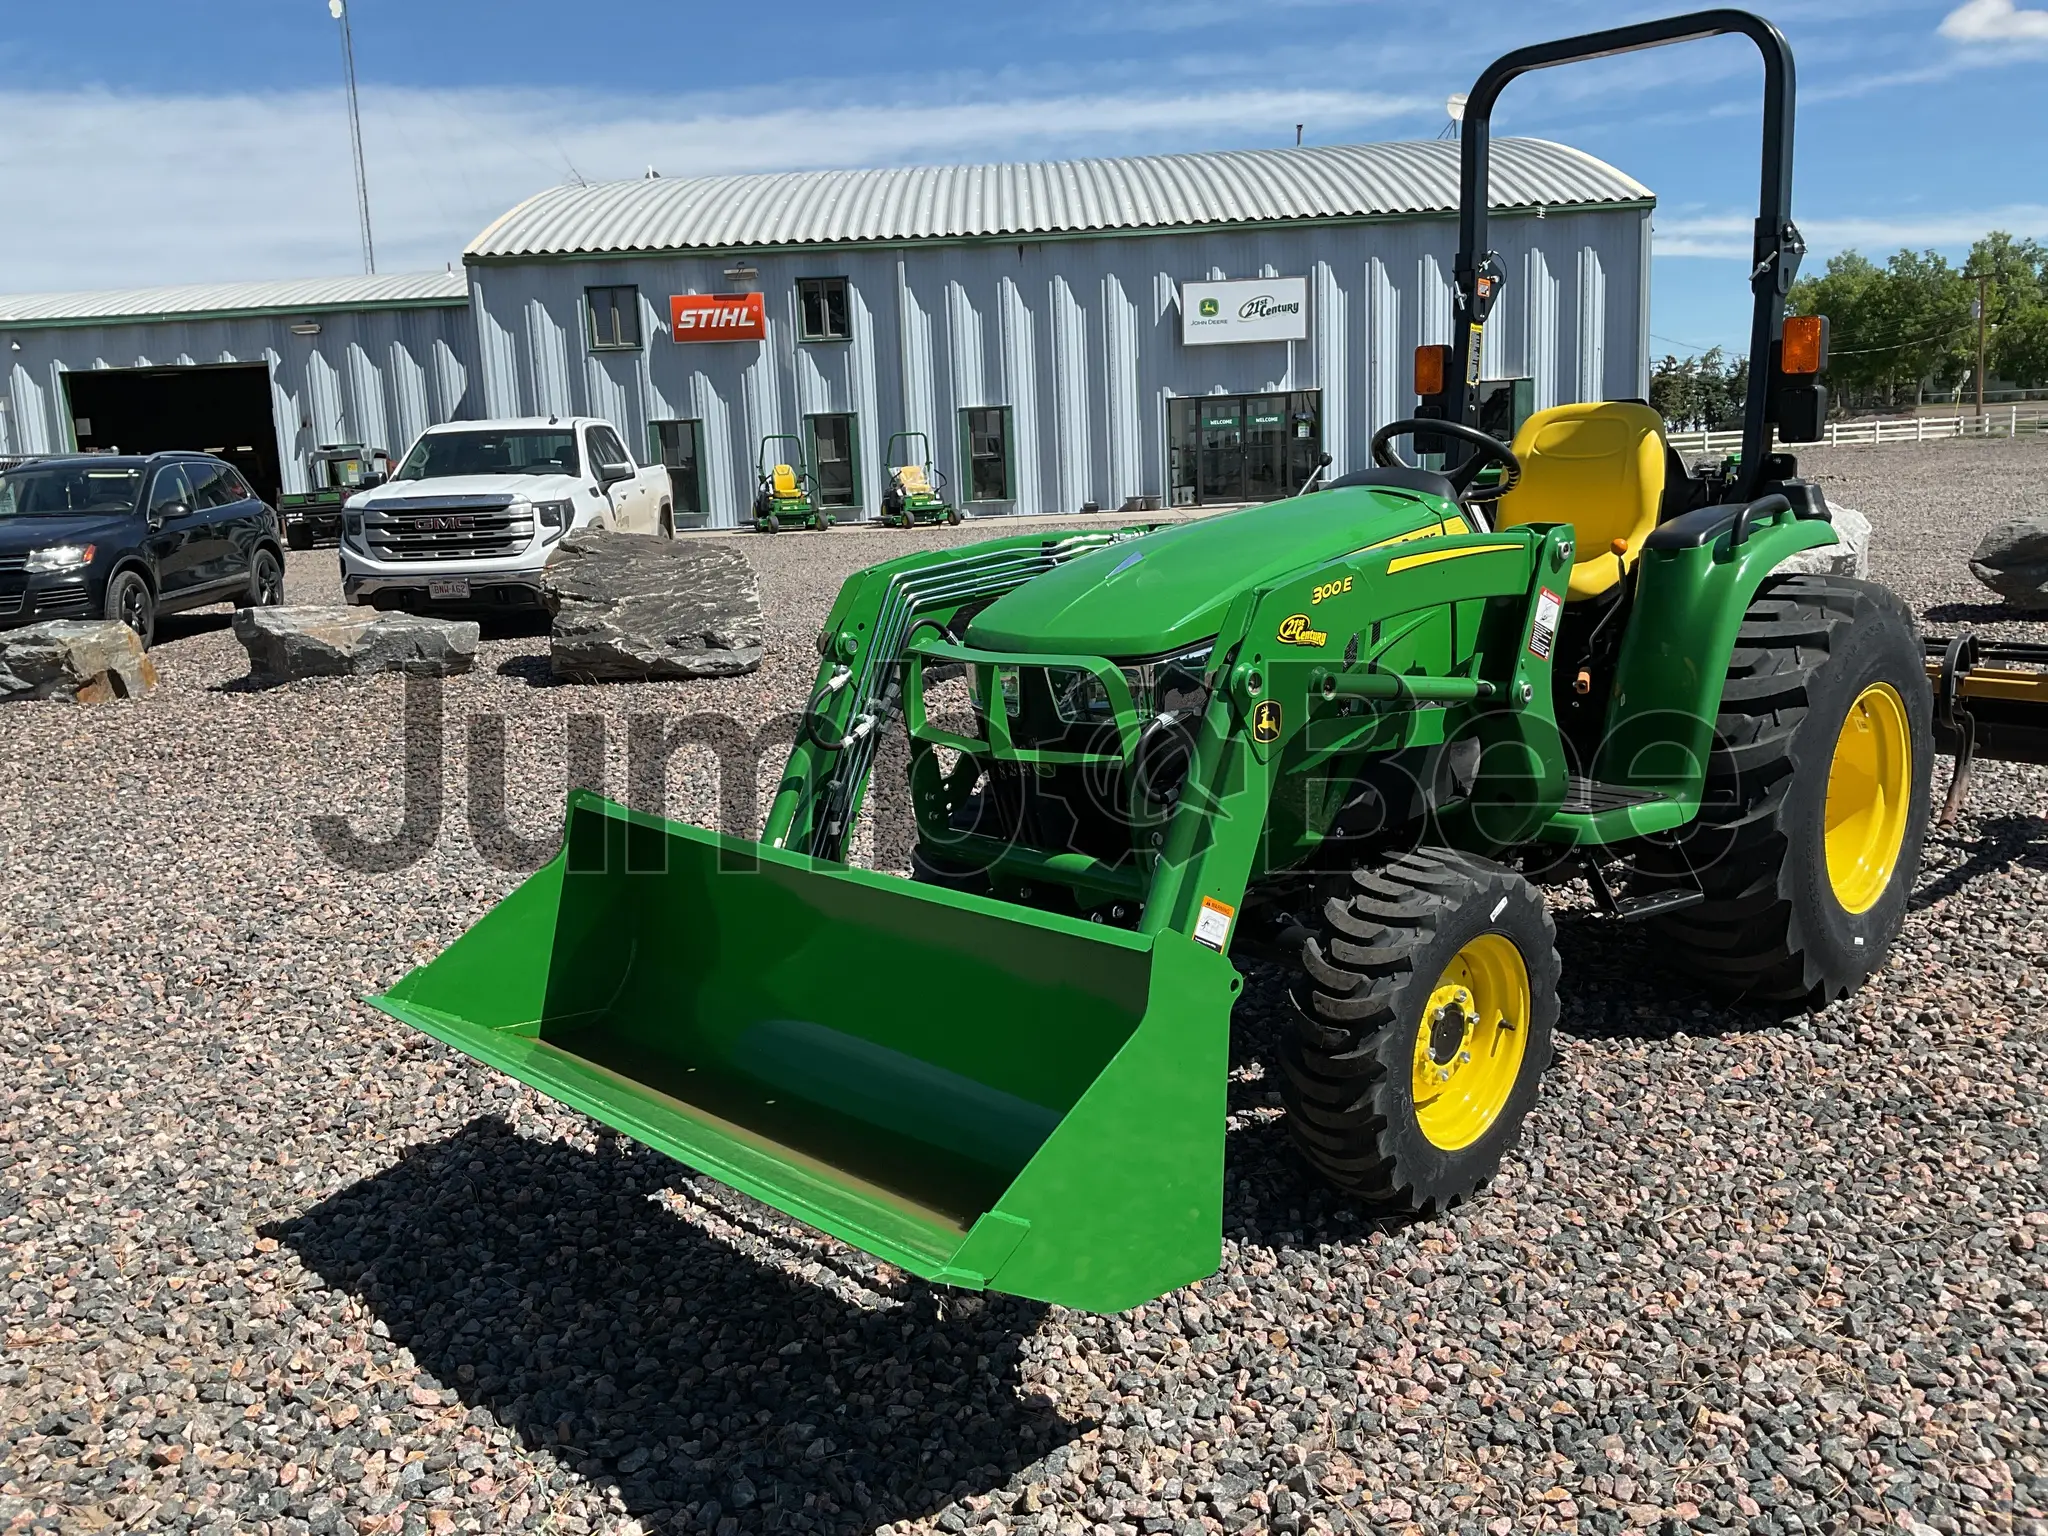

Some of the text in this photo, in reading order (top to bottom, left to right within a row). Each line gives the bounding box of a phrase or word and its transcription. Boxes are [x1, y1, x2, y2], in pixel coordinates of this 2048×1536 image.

[678, 307, 755, 328] STIHL
[1244, 298, 1268, 318] 21st
[414, 516, 475, 530] GMC
[1284, 618, 1306, 636] 21st
